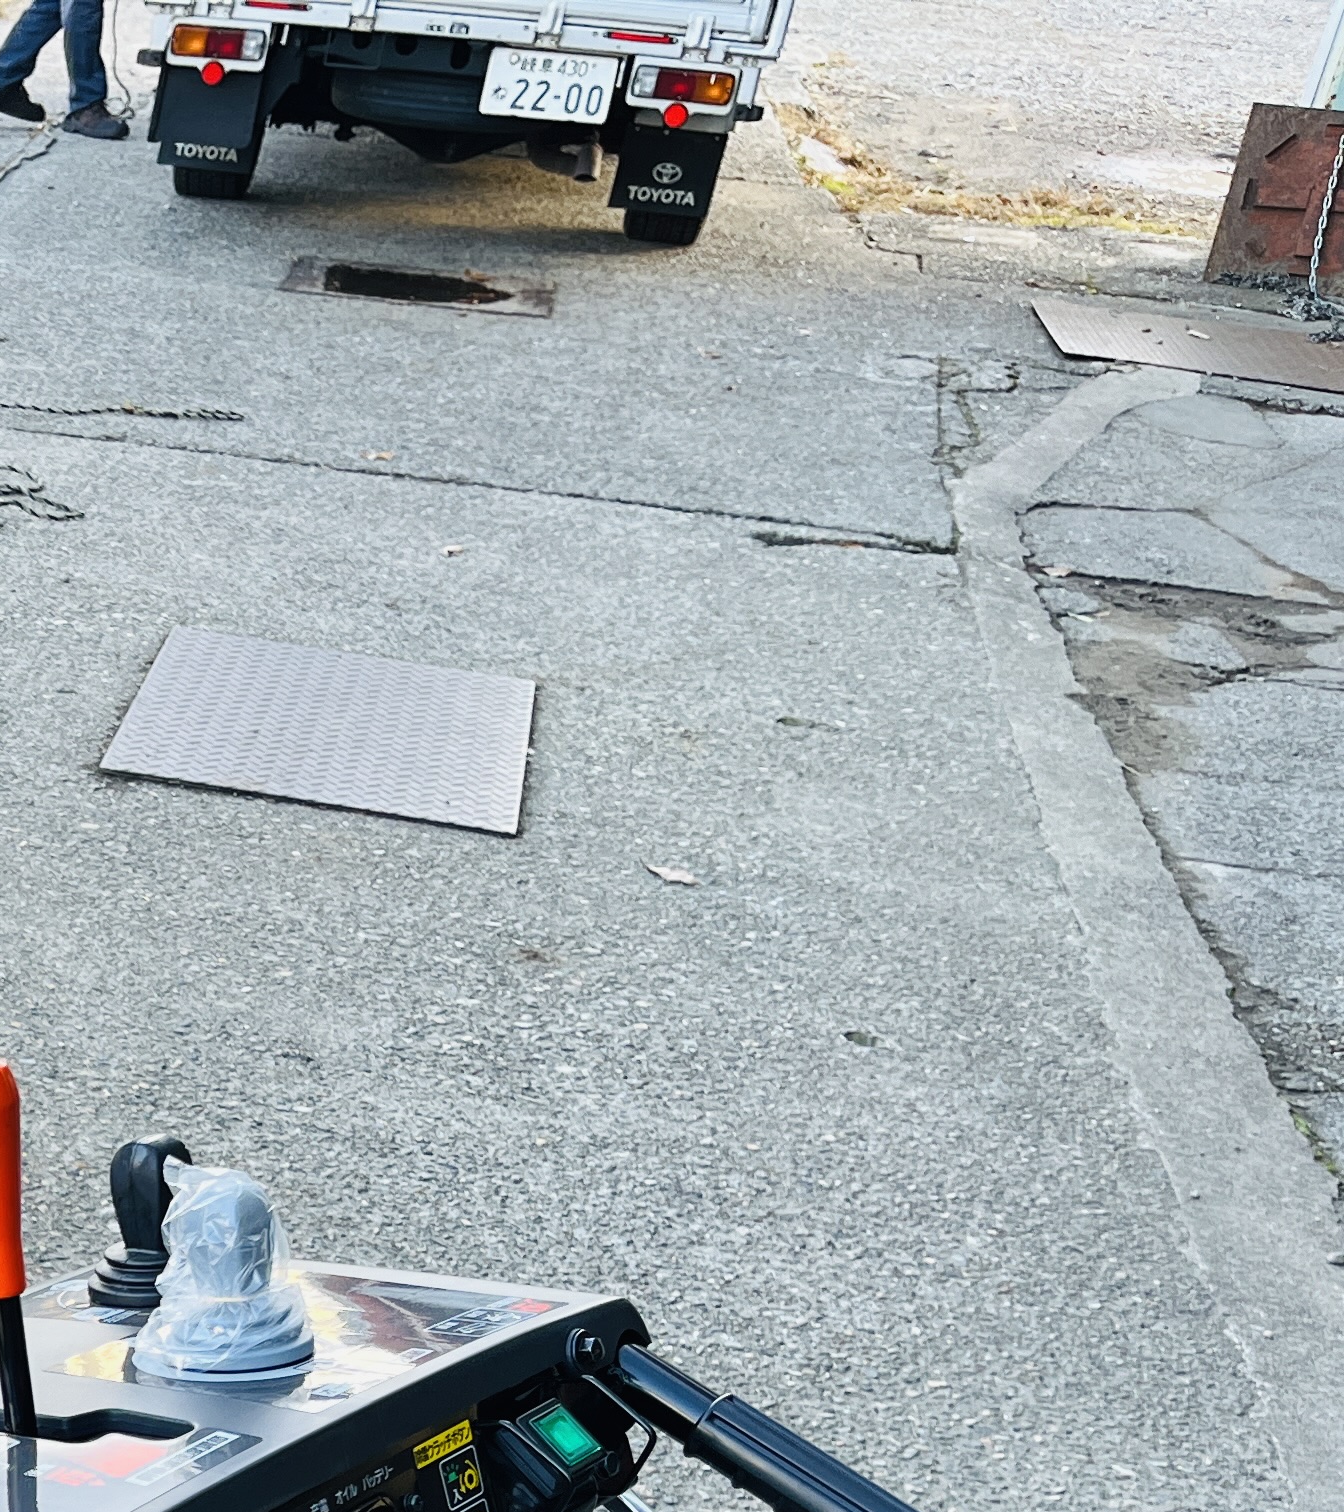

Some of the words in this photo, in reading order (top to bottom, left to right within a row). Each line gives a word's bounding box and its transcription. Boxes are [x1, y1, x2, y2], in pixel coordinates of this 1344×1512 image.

[558, 59, 589, 77] 430
[510, 78, 603, 116] 22-00
[174, 142, 238, 163] TOYOTA
[627, 185, 695, 207] TOYOTA
[334, 1483, 358, 1505] オイル
[362, 1465, 394, 1491] バッテリー
